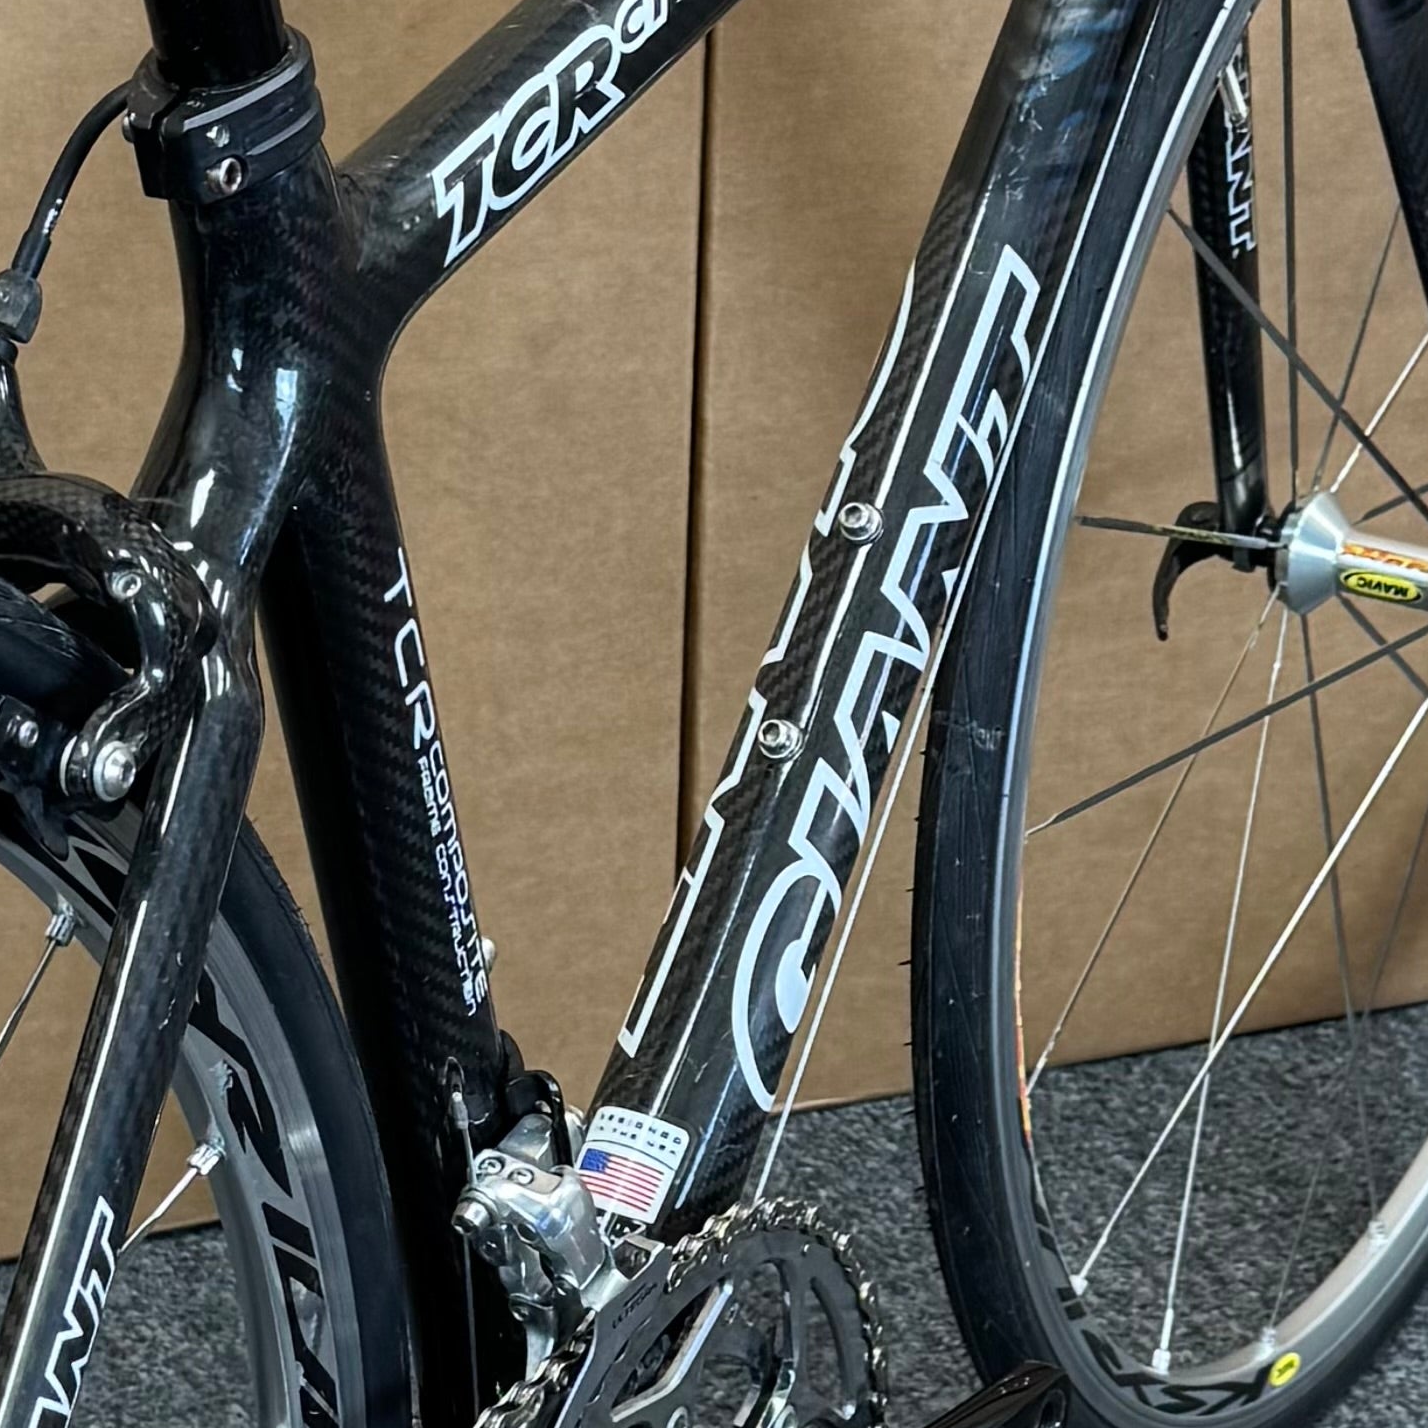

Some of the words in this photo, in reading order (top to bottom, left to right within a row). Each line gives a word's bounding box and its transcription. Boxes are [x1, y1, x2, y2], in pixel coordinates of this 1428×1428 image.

[432, 24, 626, 267] TCR
[383, 546, 436, 751] TCR
[732, 244, 1041, 1115] GIANT
[1356, 576, 1410, 598] MAVIC
